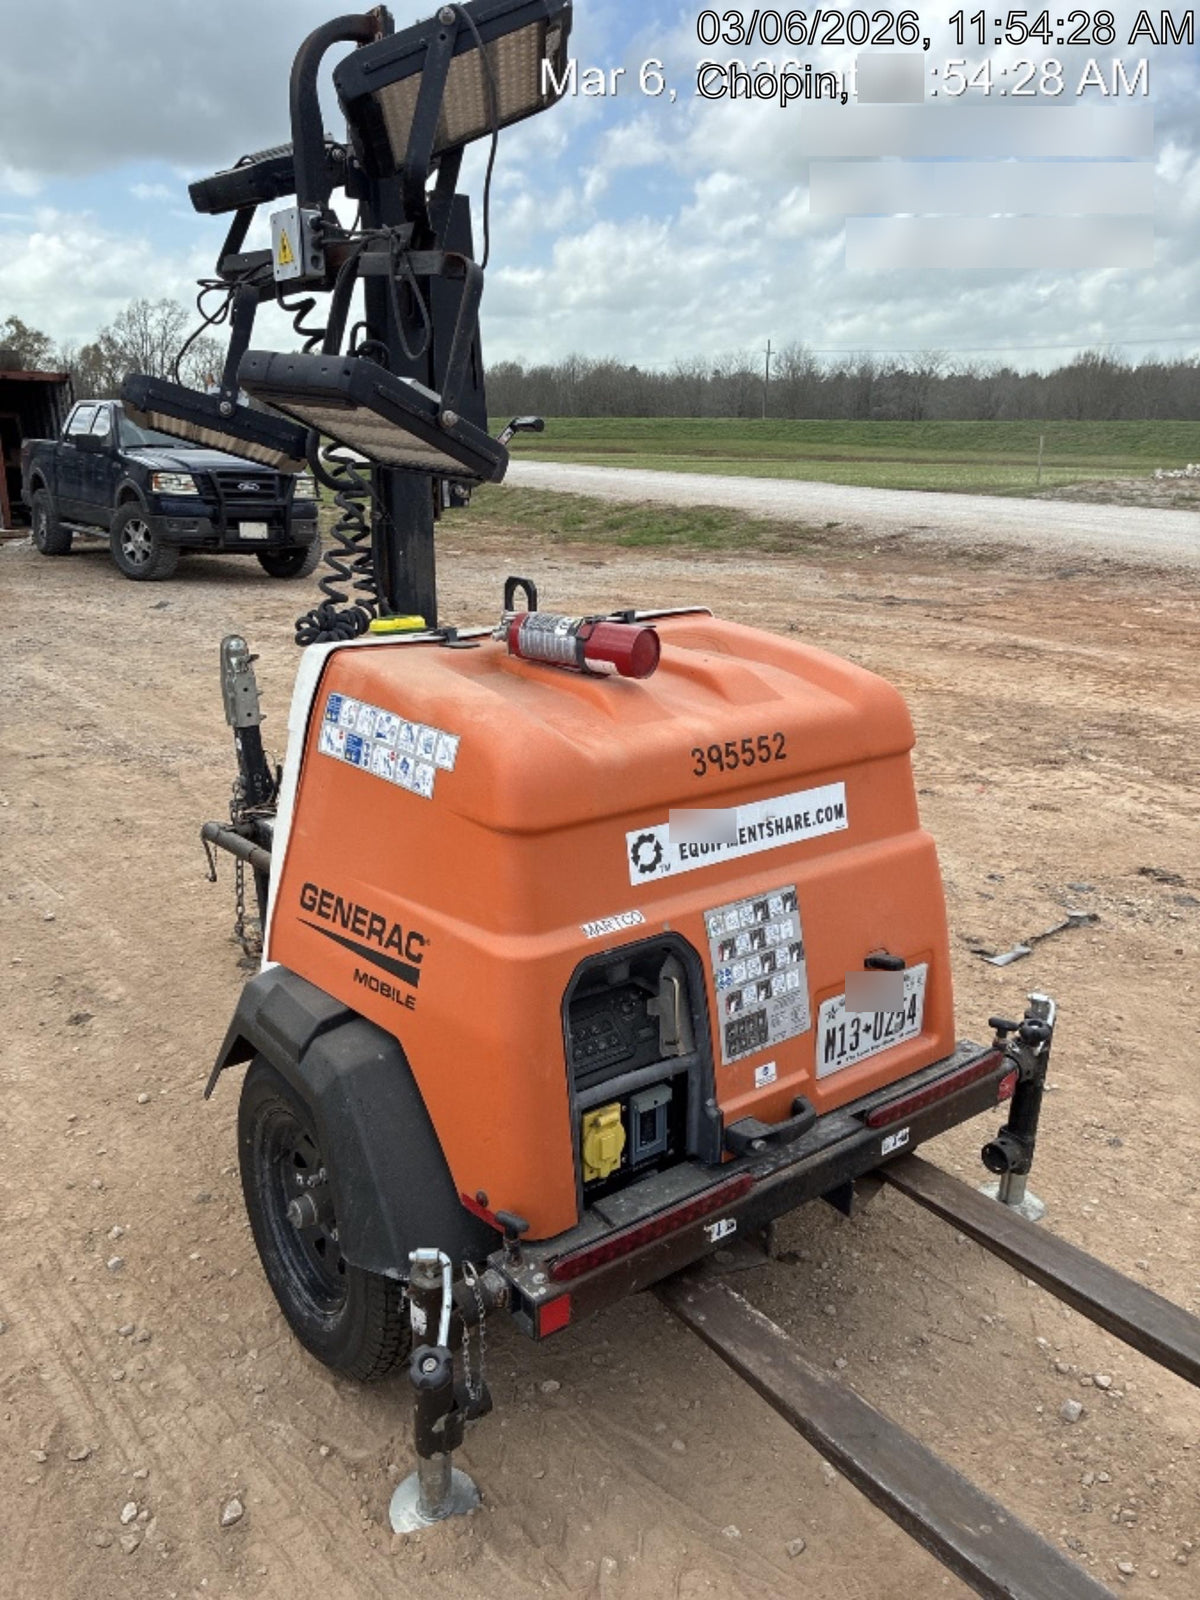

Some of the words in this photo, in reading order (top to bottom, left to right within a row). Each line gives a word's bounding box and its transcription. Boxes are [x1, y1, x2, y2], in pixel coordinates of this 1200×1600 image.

[691, 732, 787, 776] 395552
[679, 803, 844, 861] EQUIENTSHARE.COM
[300, 882, 425, 963] GENERAC
[353, 968, 416, 1011] MOBILE
